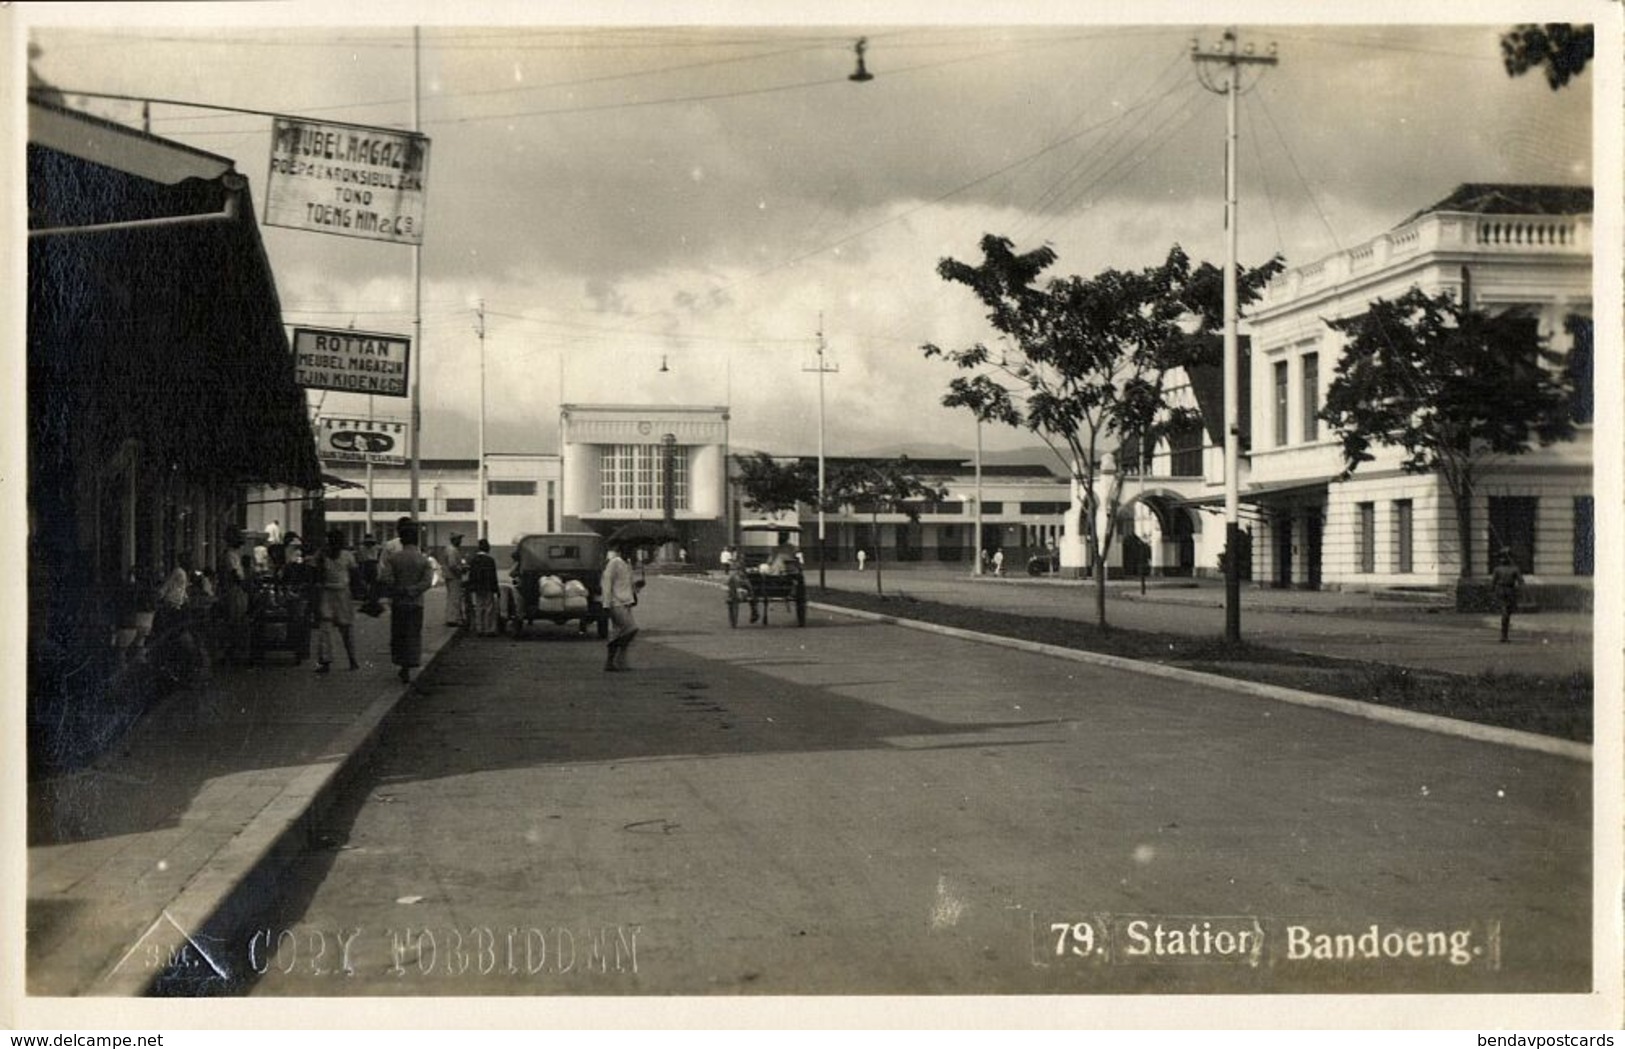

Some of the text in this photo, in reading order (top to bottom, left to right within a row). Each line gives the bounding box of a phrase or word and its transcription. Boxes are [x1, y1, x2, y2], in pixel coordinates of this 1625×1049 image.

[305, 202, 352, 227] TOENG
[315, 335, 388, 356] ROTTAN
[298, 353, 344, 369] MEUBEL
